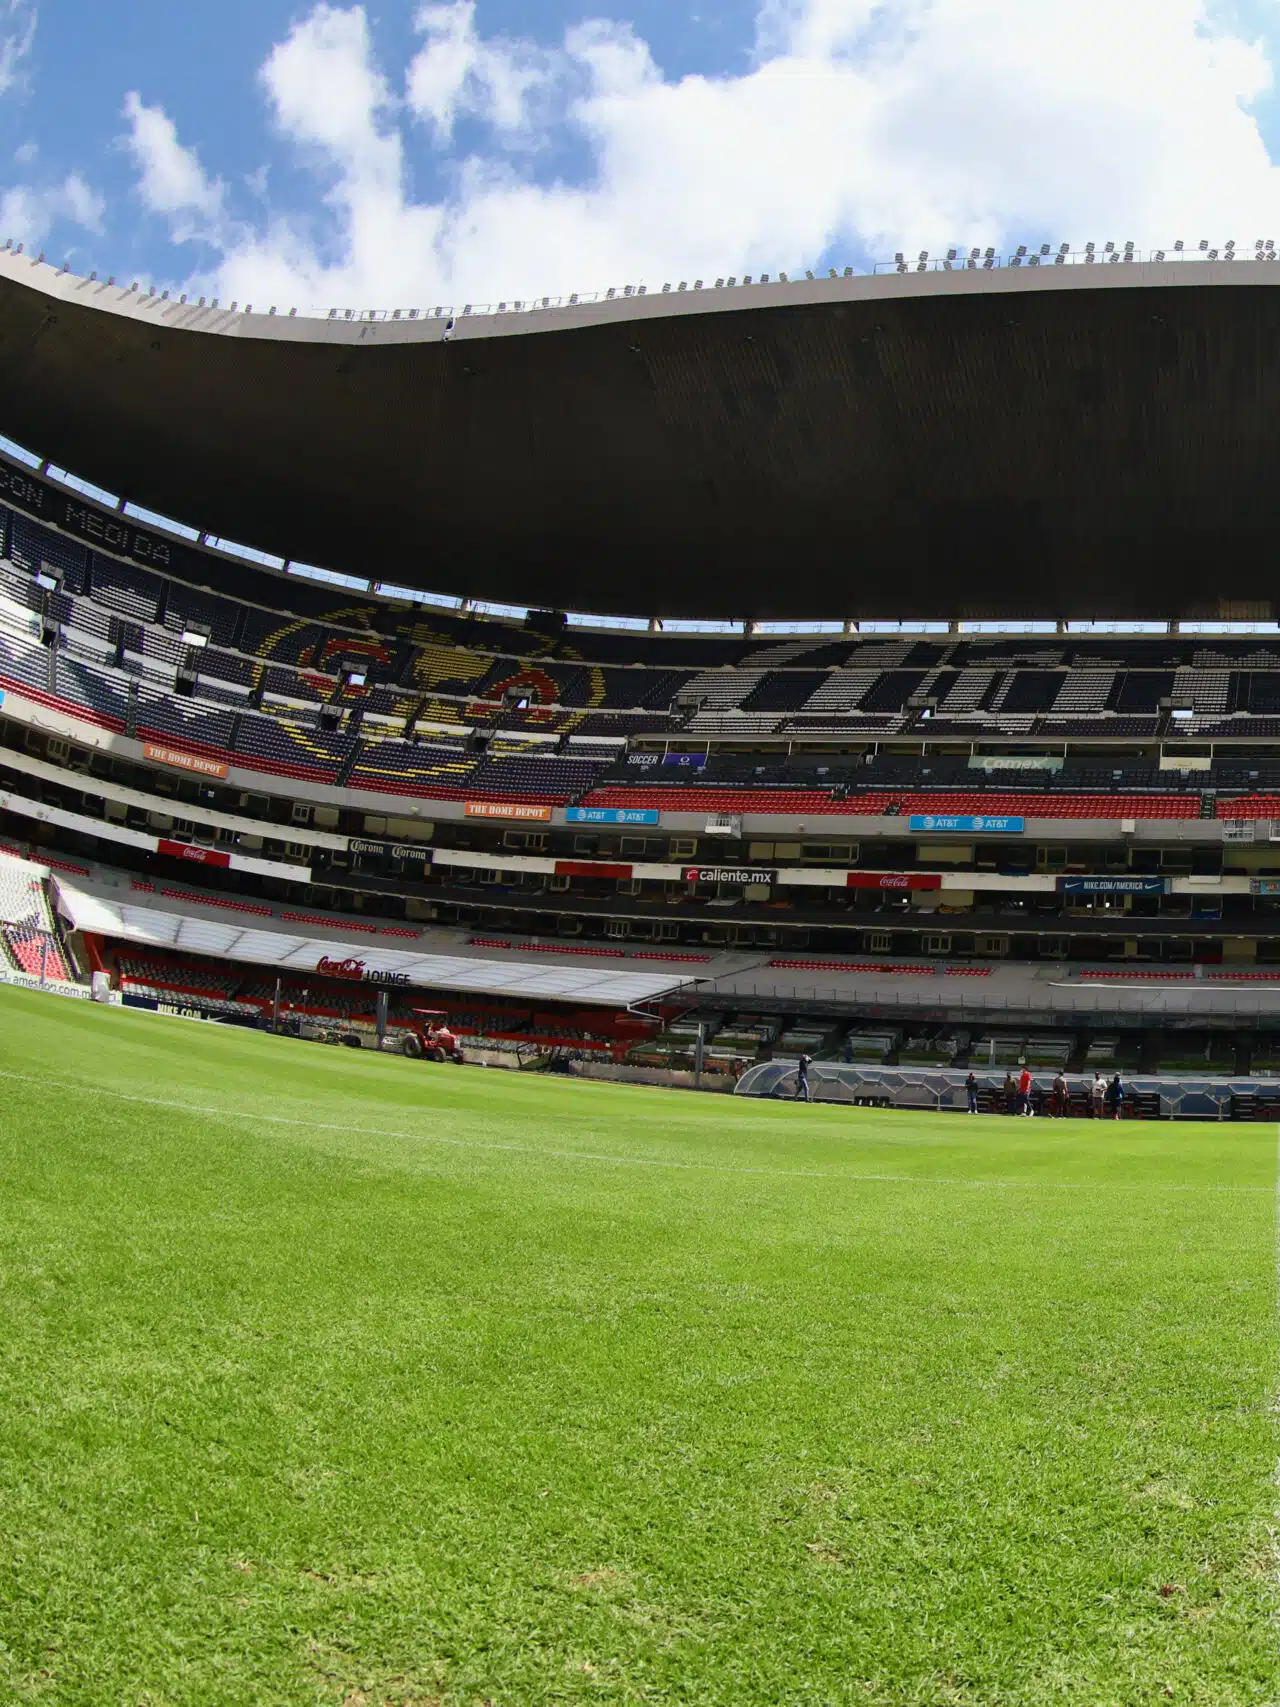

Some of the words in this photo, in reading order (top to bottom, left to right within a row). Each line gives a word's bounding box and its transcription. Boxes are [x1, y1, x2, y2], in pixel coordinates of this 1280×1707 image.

[149, 747, 166, 760] THE
[167, 752, 193, 766] HOME
[193, 759, 224, 774] DEPOT
[627, 755, 659, 765] SOCCER
[983, 757, 1048, 769] Comex
[469, 804, 487, 814] THE
[488, 805, 513, 816] HOME
[515, 807, 546, 818] DEPOT
[587, 811, 606, 820] AT&T
[626, 813, 647, 822] AT&T
[936, 818, 959, 828] AT&T
[985, 819, 1008, 829] AT&T
[350, 840, 384, 854] Corona
[391, 845, 426, 860] Corona
[699, 869, 772, 884] caliente.mx
[366, 969, 411, 985] LOUNGE
